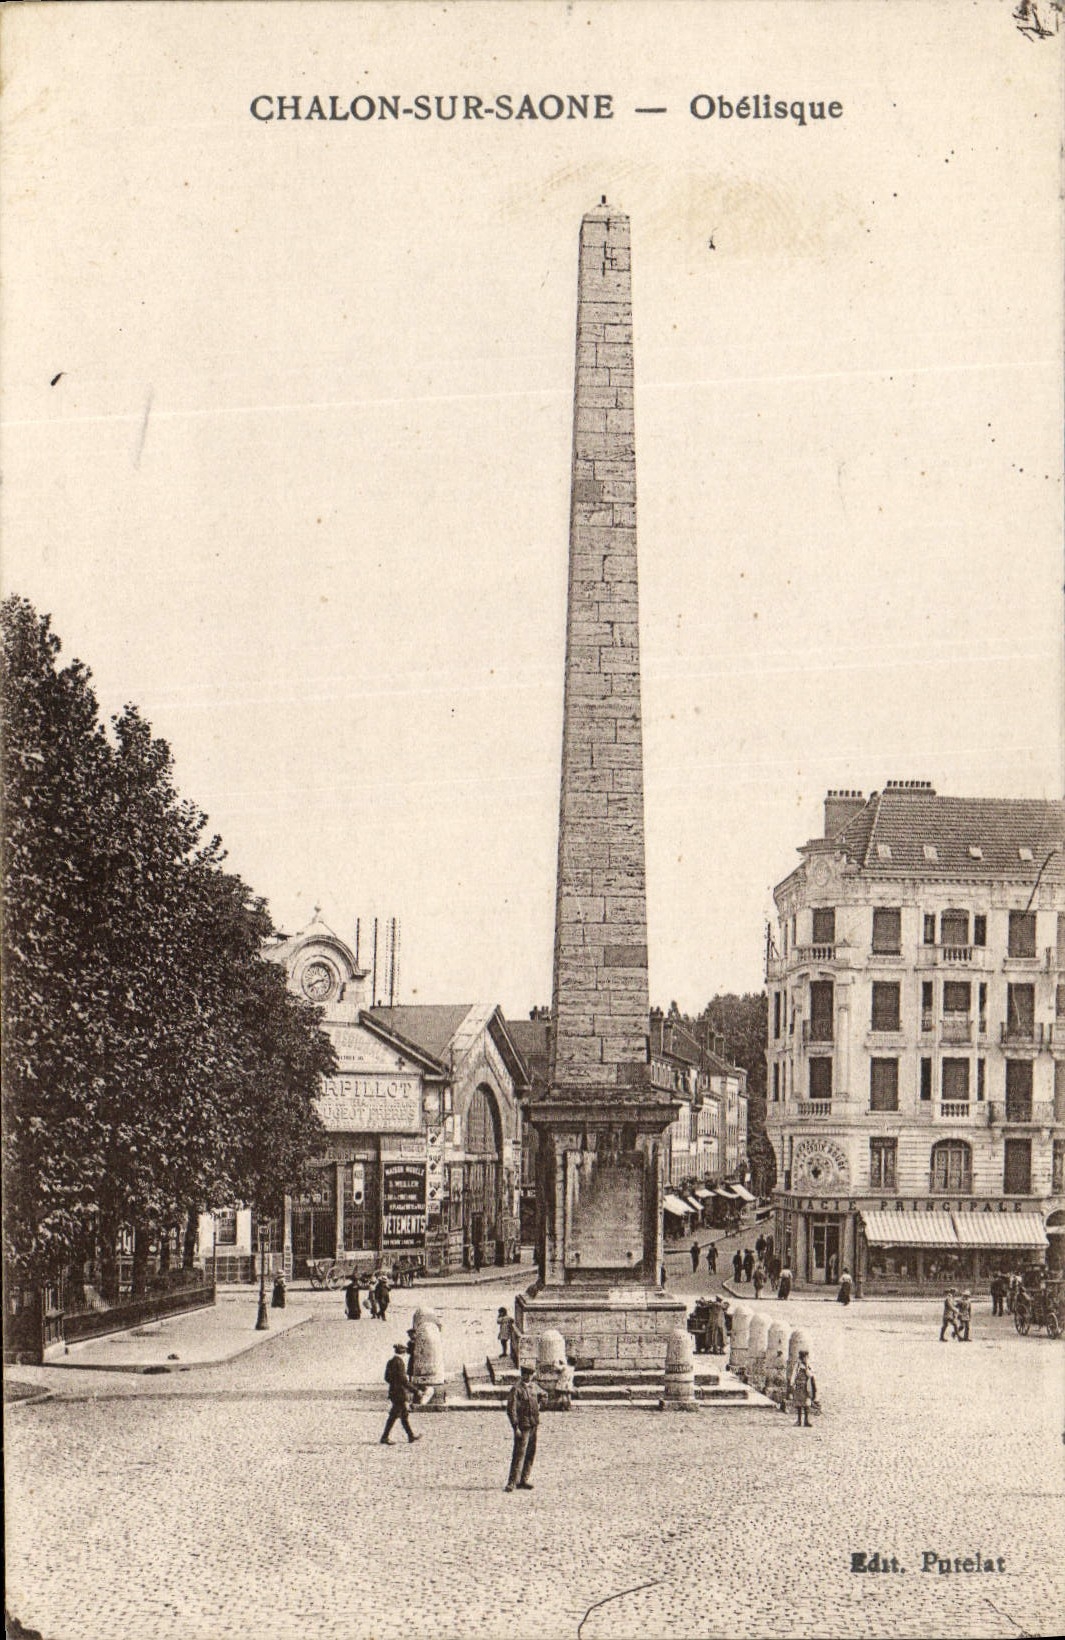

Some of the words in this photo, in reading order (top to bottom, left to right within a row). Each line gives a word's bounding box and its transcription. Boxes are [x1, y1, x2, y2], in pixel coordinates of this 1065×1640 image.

[321, 1081, 411, 1098] RPILLOT
[323, 1107, 365, 1120] UGEOT
[880, 1200, 1022, 1213] PRINCIPALE
